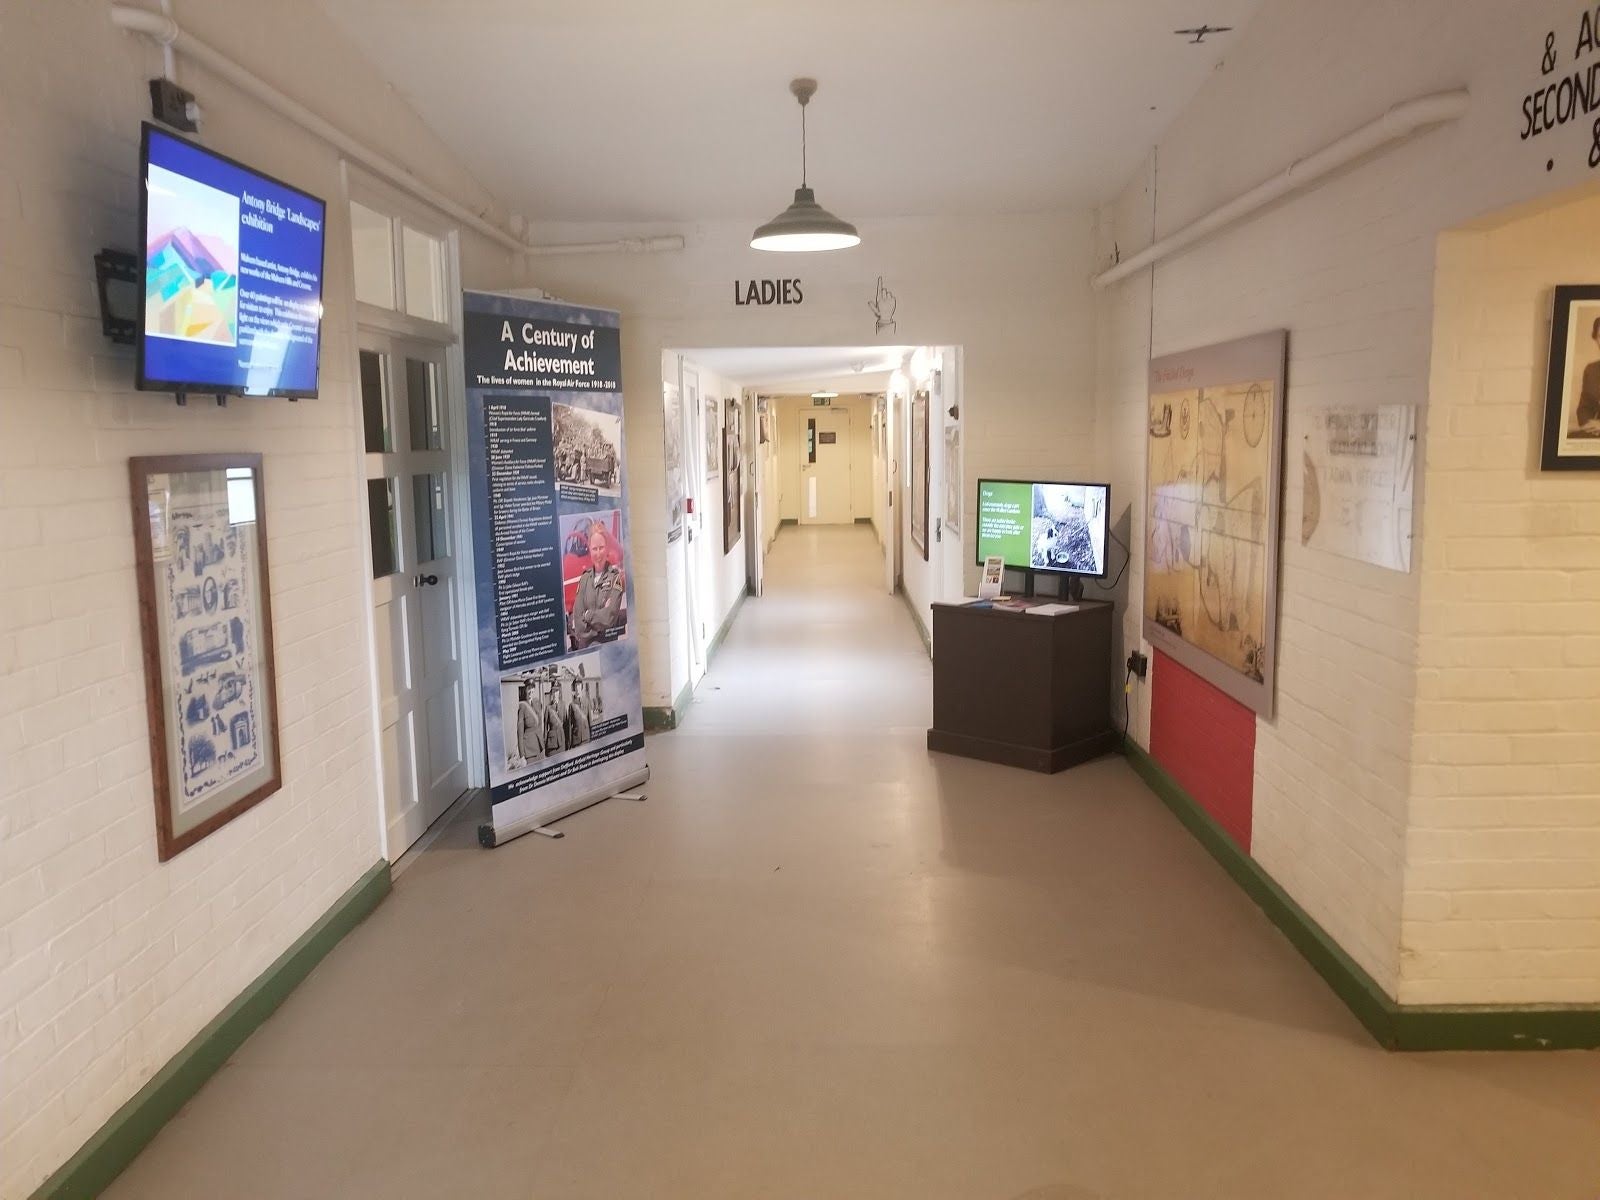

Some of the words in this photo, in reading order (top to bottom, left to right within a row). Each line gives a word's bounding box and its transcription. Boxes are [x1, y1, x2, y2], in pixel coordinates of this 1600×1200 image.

[1541, 31, 1557, 75] &
[242, 189, 266, 214] Antony
[266, 199, 286, 221] Bridge
[241, 211, 274, 234] exhibition
[735, 279, 803, 305] LADIES
[501, 320, 514, 342] A
[522, 322, 577, 353] Century
[581, 330, 595, 349] of
[504, 349, 595, 375] Achievement
[477, 375, 490, 384] The
[491, 376, 505, 385] lives
[506, 376, 512, 385] of
[513, 378, 534, 386] women
[536, 378, 541, 386] in
[542, 378, 552, 386] the
[552, 378, 567, 389] Royal
[576, 379, 590, 388] Force
